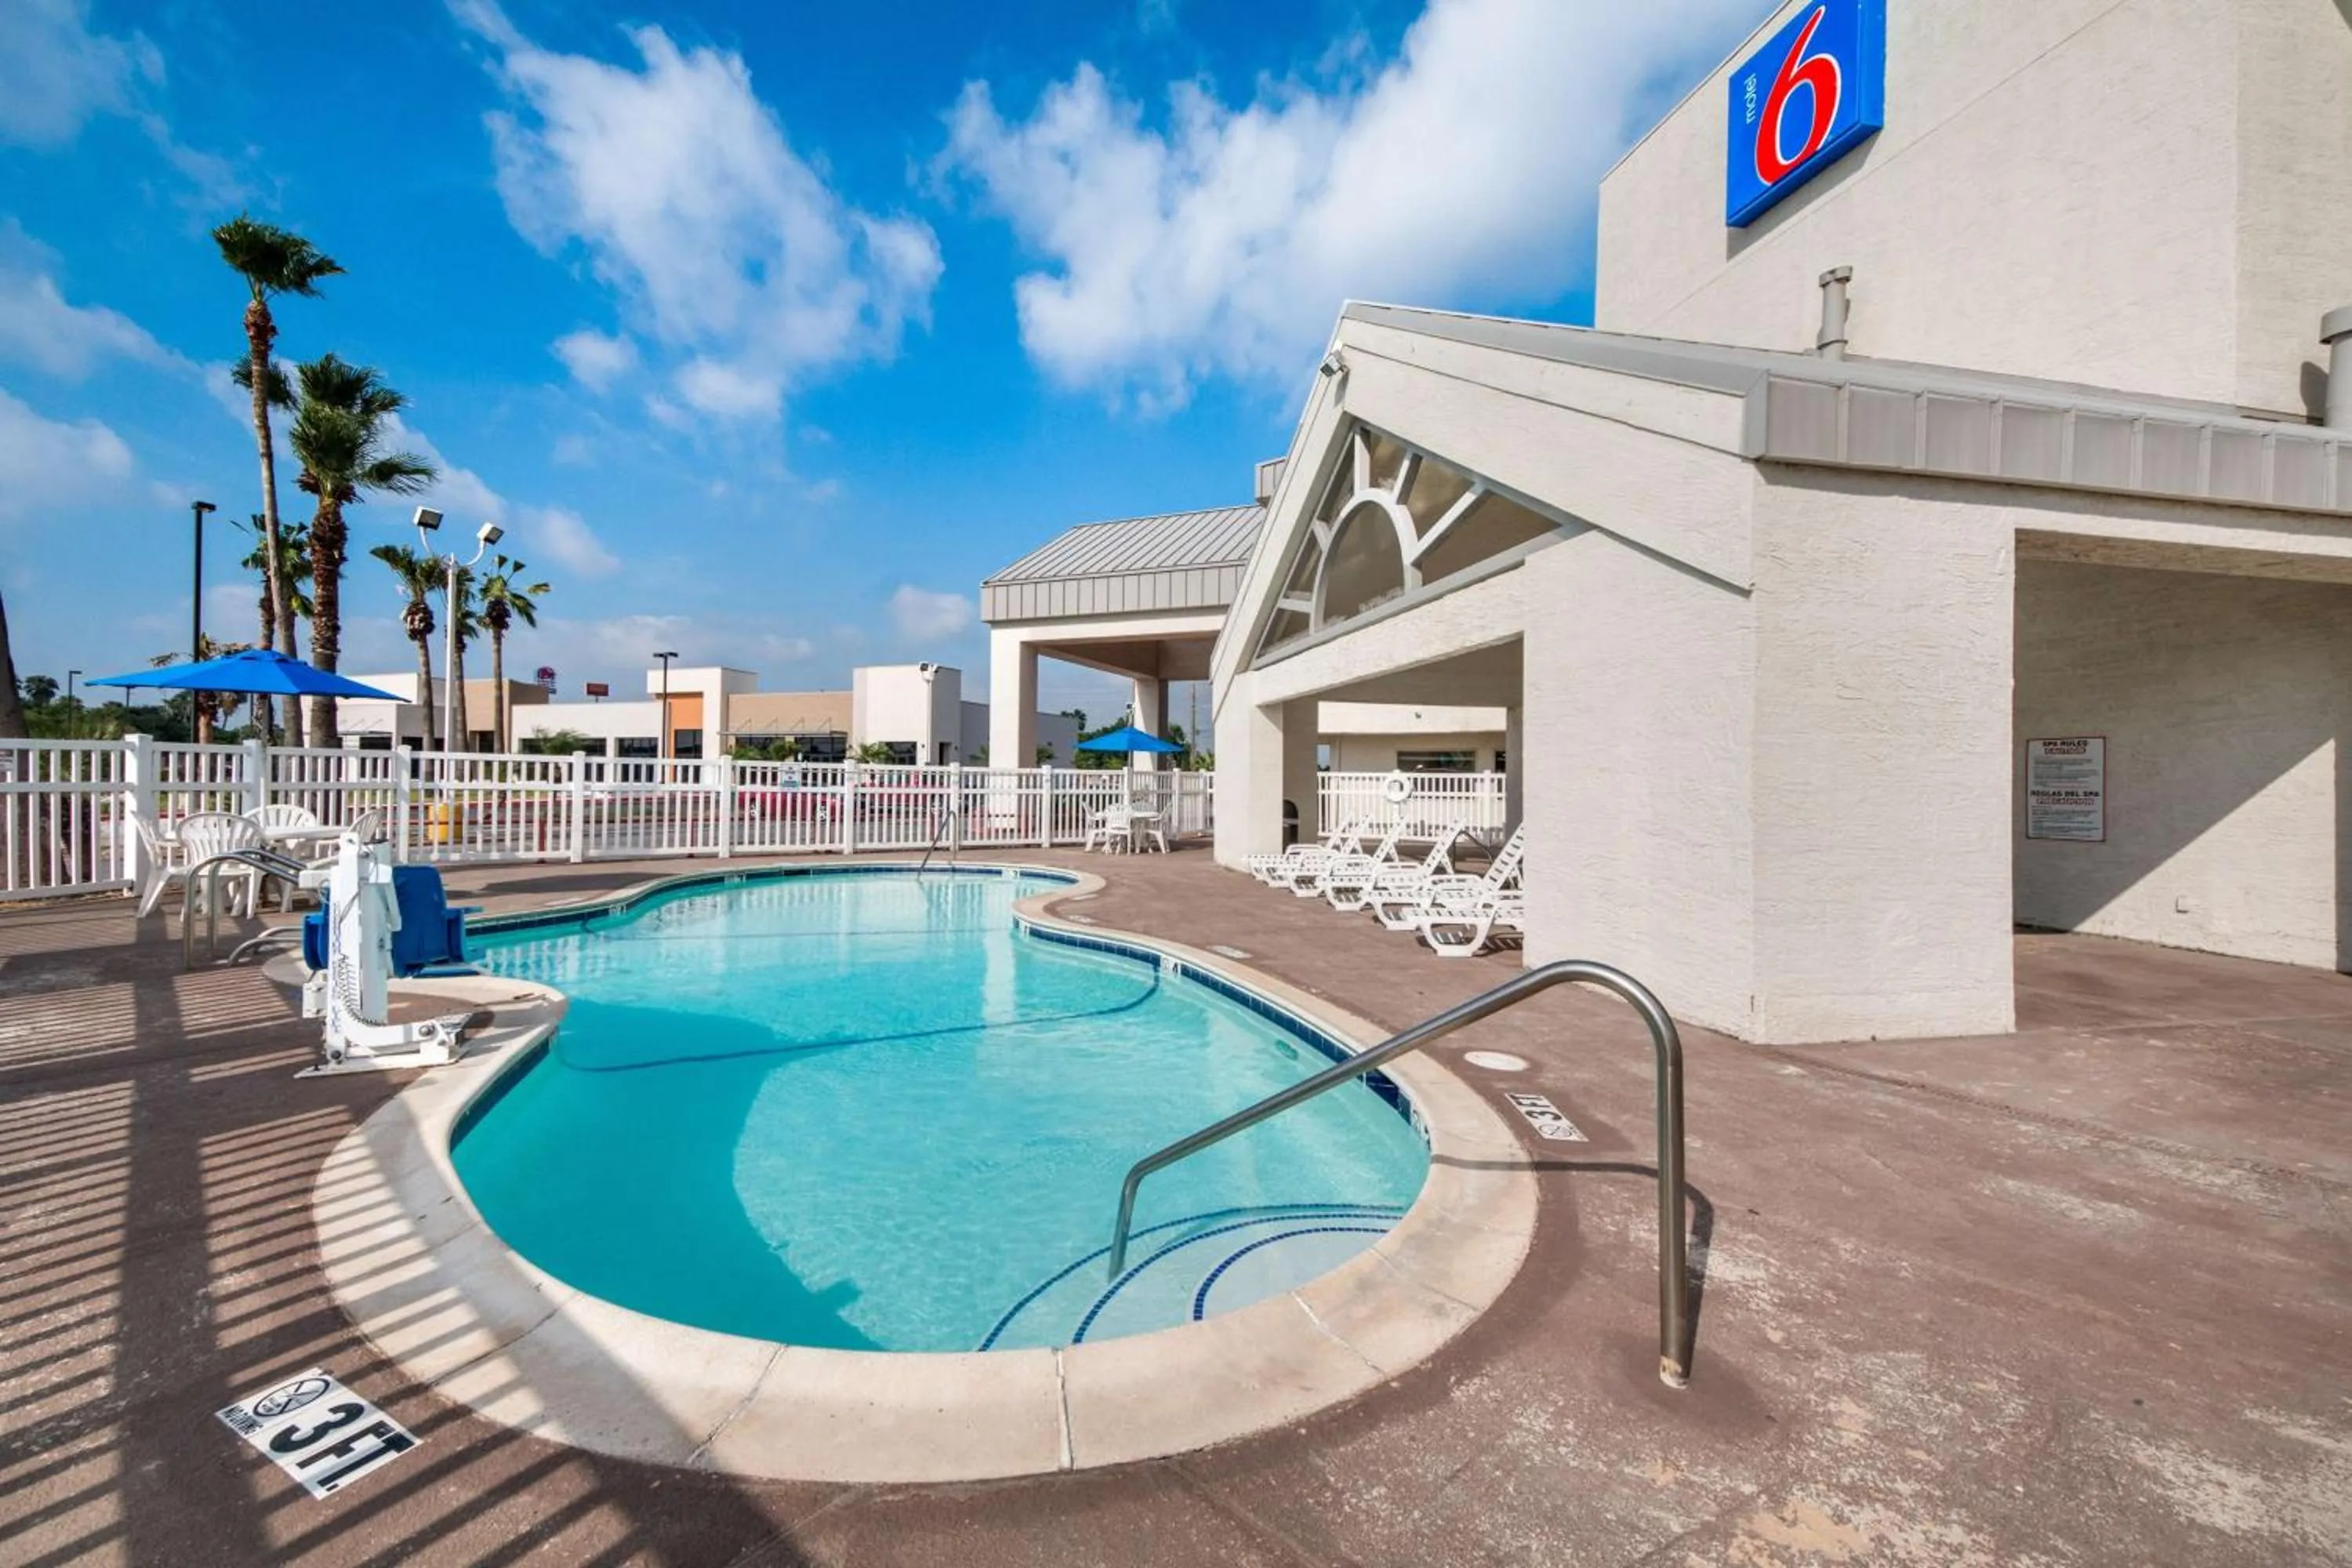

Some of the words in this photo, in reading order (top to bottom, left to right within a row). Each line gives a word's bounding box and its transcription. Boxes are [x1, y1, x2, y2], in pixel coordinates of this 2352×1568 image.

[1744, 73, 1756, 125] motel
[1755, 5, 1842, 186] 6
[1525, 1110, 1563, 1121] 3
[270, 1403, 365, 1453] 3
